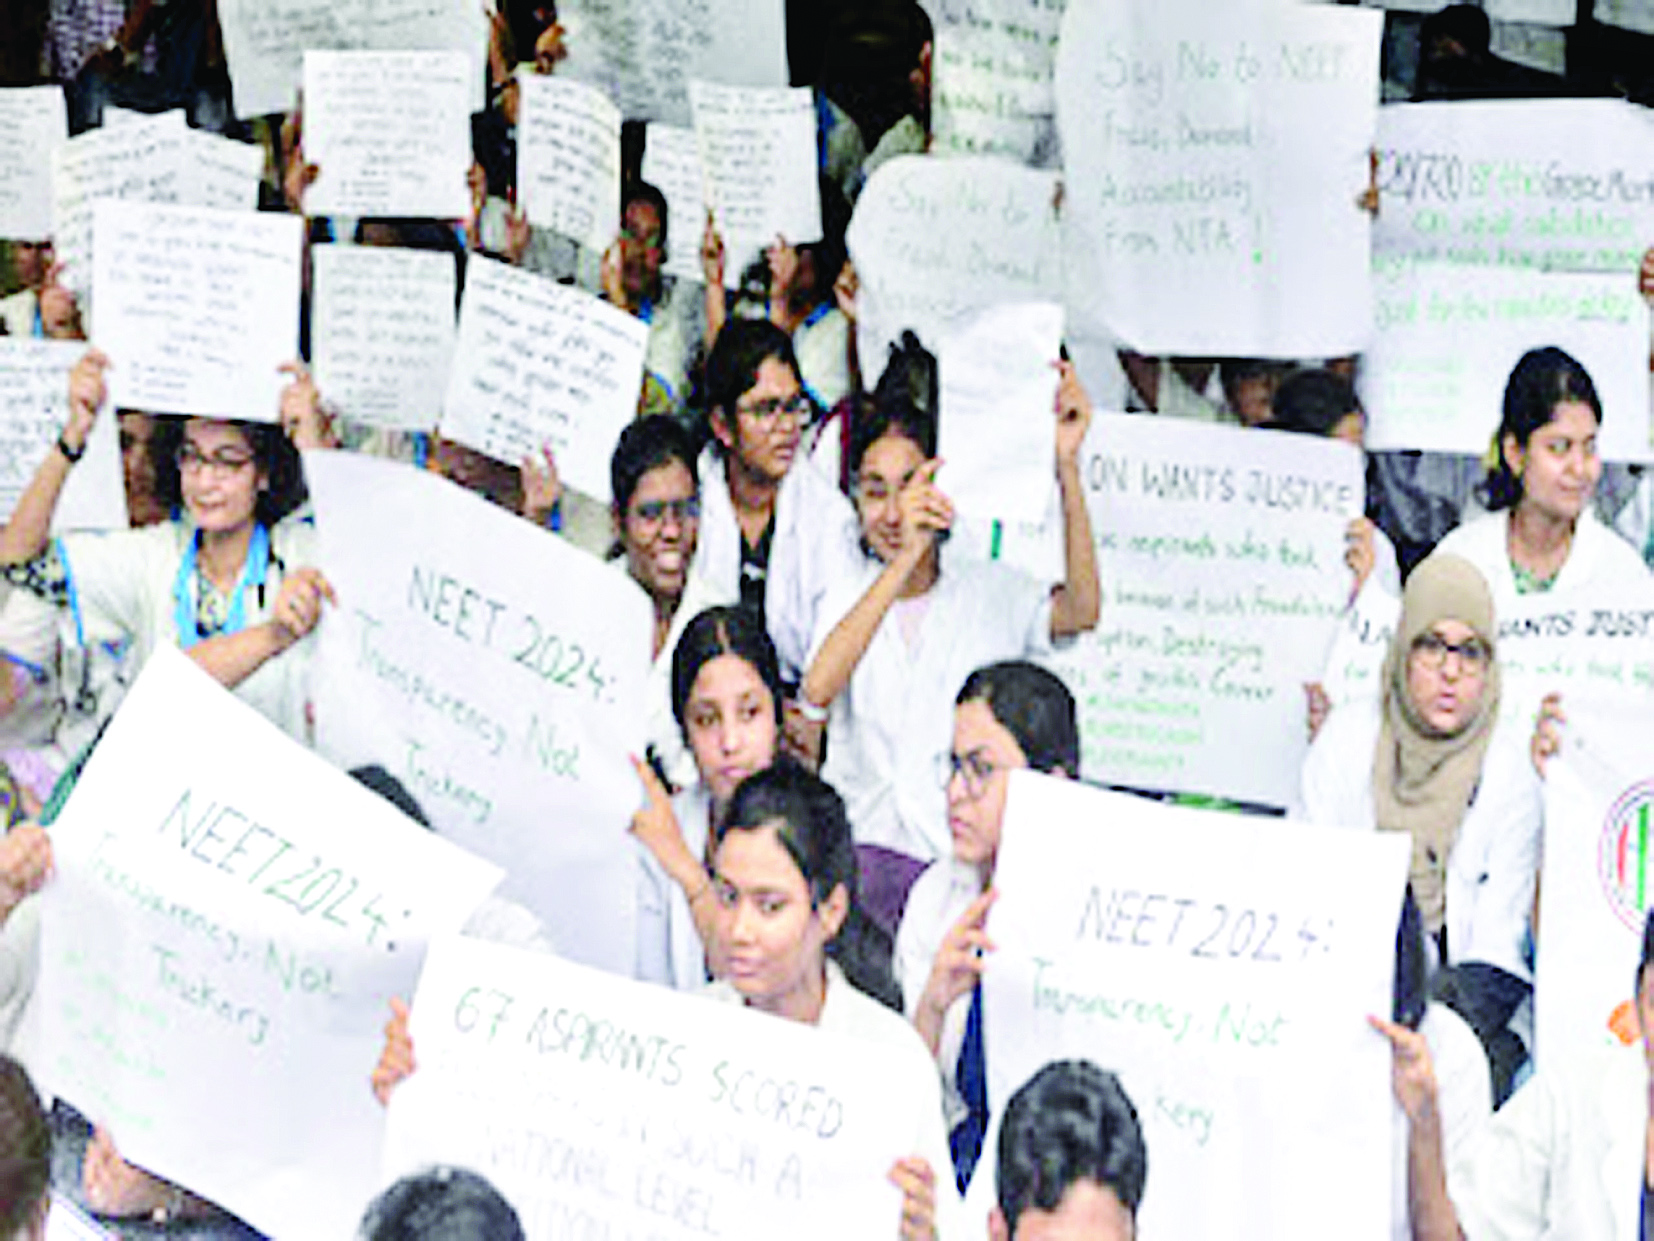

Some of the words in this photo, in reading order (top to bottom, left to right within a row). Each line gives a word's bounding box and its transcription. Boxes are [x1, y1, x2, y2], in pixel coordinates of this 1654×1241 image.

[1176, 42, 1220, 82] No
[1235, 42, 1261, 84] to
[1084, 453, 1128, 494] ON
[1141, 460, 1235, 504] WANTS
[1246, 466, 1353, 518] JUSTICE
[407, 563, 507, 648] NEET
[511, 613, 618, 704] 2024:
[521, 711, 582, 782] Not
[157, 788, 296, 885] NEET
[261, 854, 413, 952] 2024:
[1073, 883, 1199, 947] NEET
[1188, 902, 1335, 963] 2024:
[454, 984, 515, 1045] 67
[526, 1005, 689, 1089] ASPIRANTS
[709, 1058, 843, 1141] SCORED
[1211, 1001, 1292, 1049] Not
